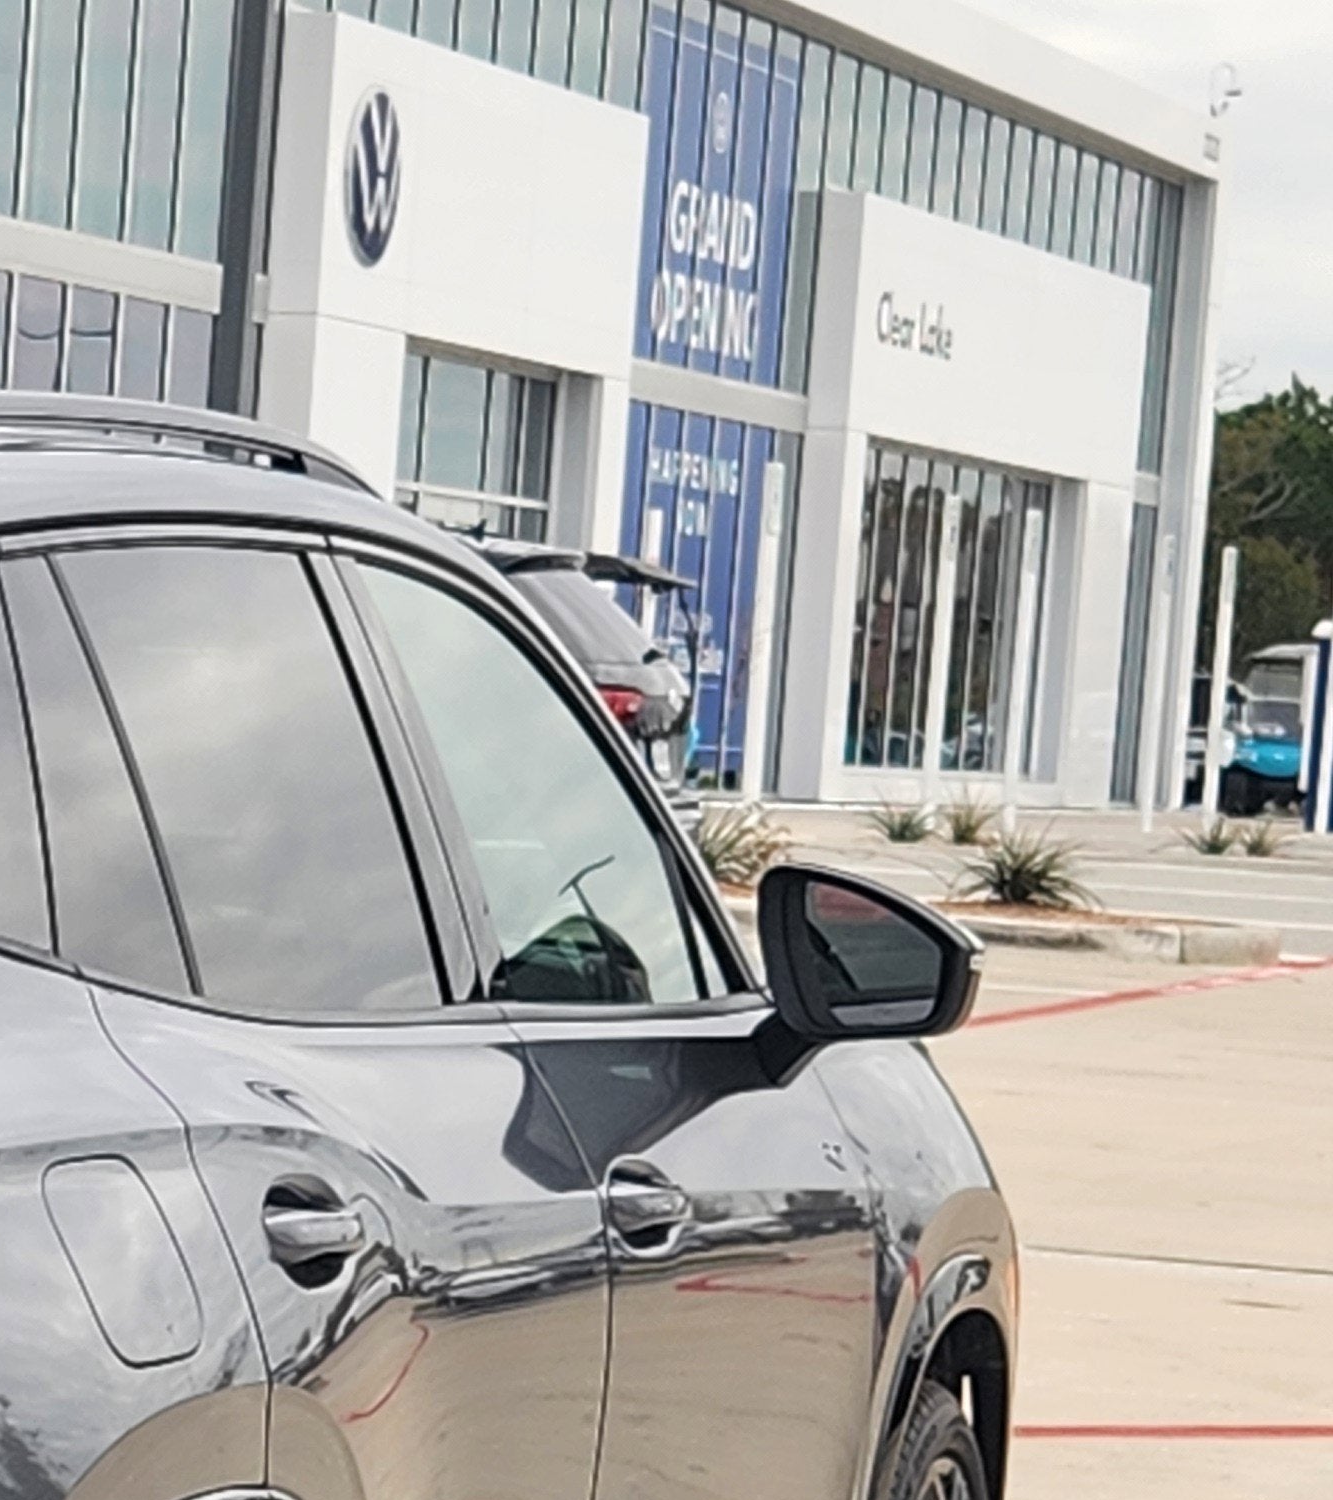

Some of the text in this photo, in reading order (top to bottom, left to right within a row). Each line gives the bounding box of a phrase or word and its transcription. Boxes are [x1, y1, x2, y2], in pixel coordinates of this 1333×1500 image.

[670, 181, 756, 271] GRAND
[651, 270, 758, 362] OPENING
[877, 291, 953, 360] Clear Lake
